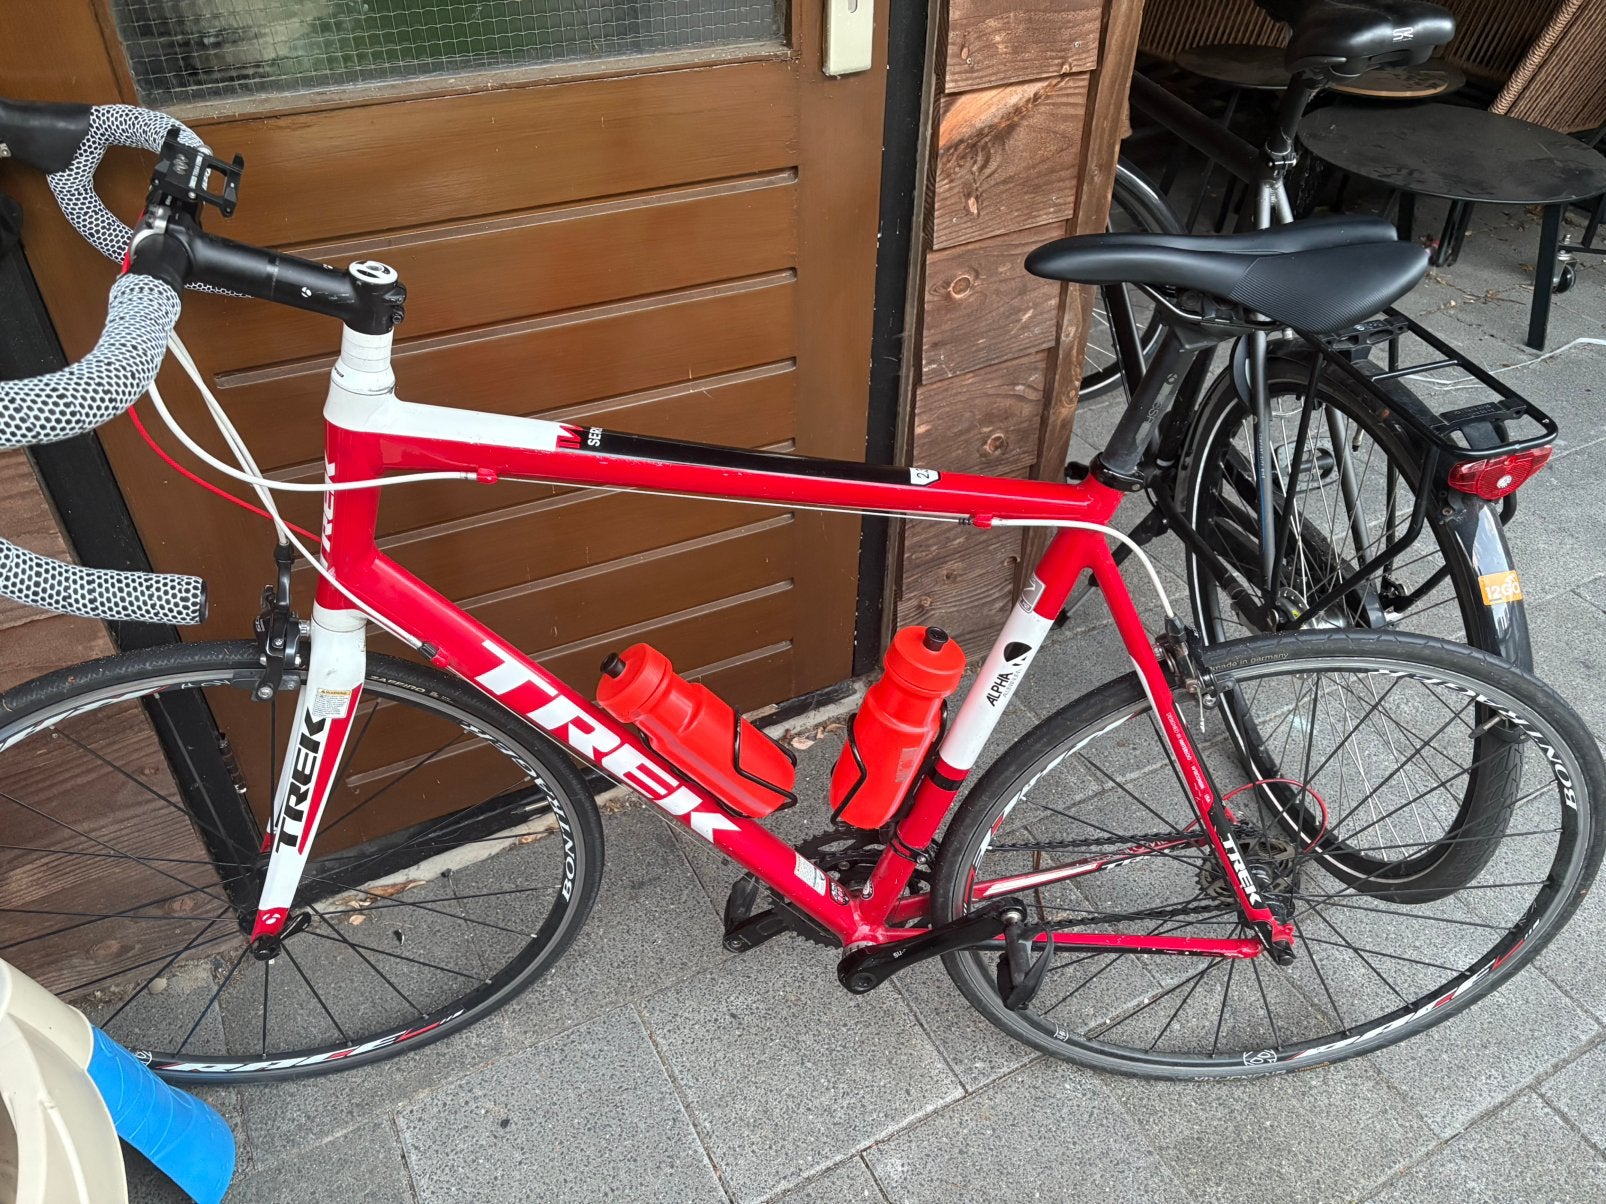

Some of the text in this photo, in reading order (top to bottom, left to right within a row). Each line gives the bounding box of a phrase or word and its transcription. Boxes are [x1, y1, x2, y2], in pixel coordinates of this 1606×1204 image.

[474, 640, 741, 844] TREK
[986, 672, 1013, 707] ALPHA
[276, 705, 327, 853] TREK
[459, 723, 577, 903] BONTRAGER
[1222, 833, 1263, 905] TREK
